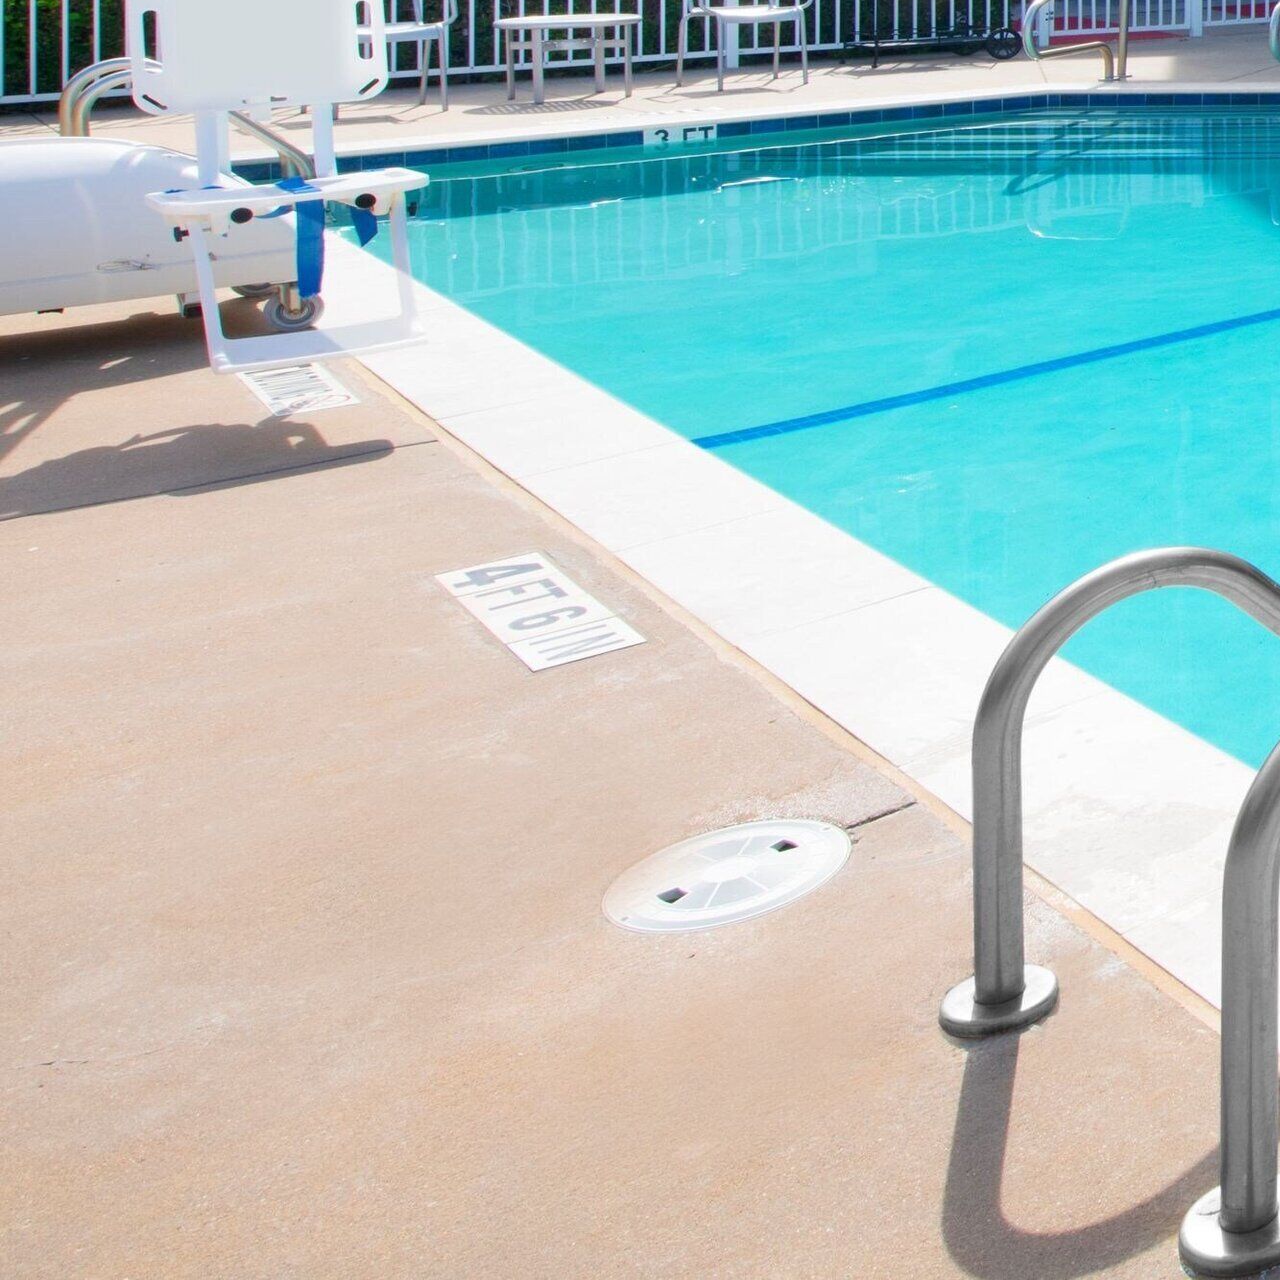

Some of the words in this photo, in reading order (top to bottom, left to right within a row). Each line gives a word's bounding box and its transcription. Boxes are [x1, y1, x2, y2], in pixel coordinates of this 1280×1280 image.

[654, 128, 669, 143] 3
[682, 125, 714, 142] FT
[452, 562, 545, 589] 4
[475, 578, 568, 611] FT
[508, 605, 588, 631] 6
[529, 624, 626, 662] IN
